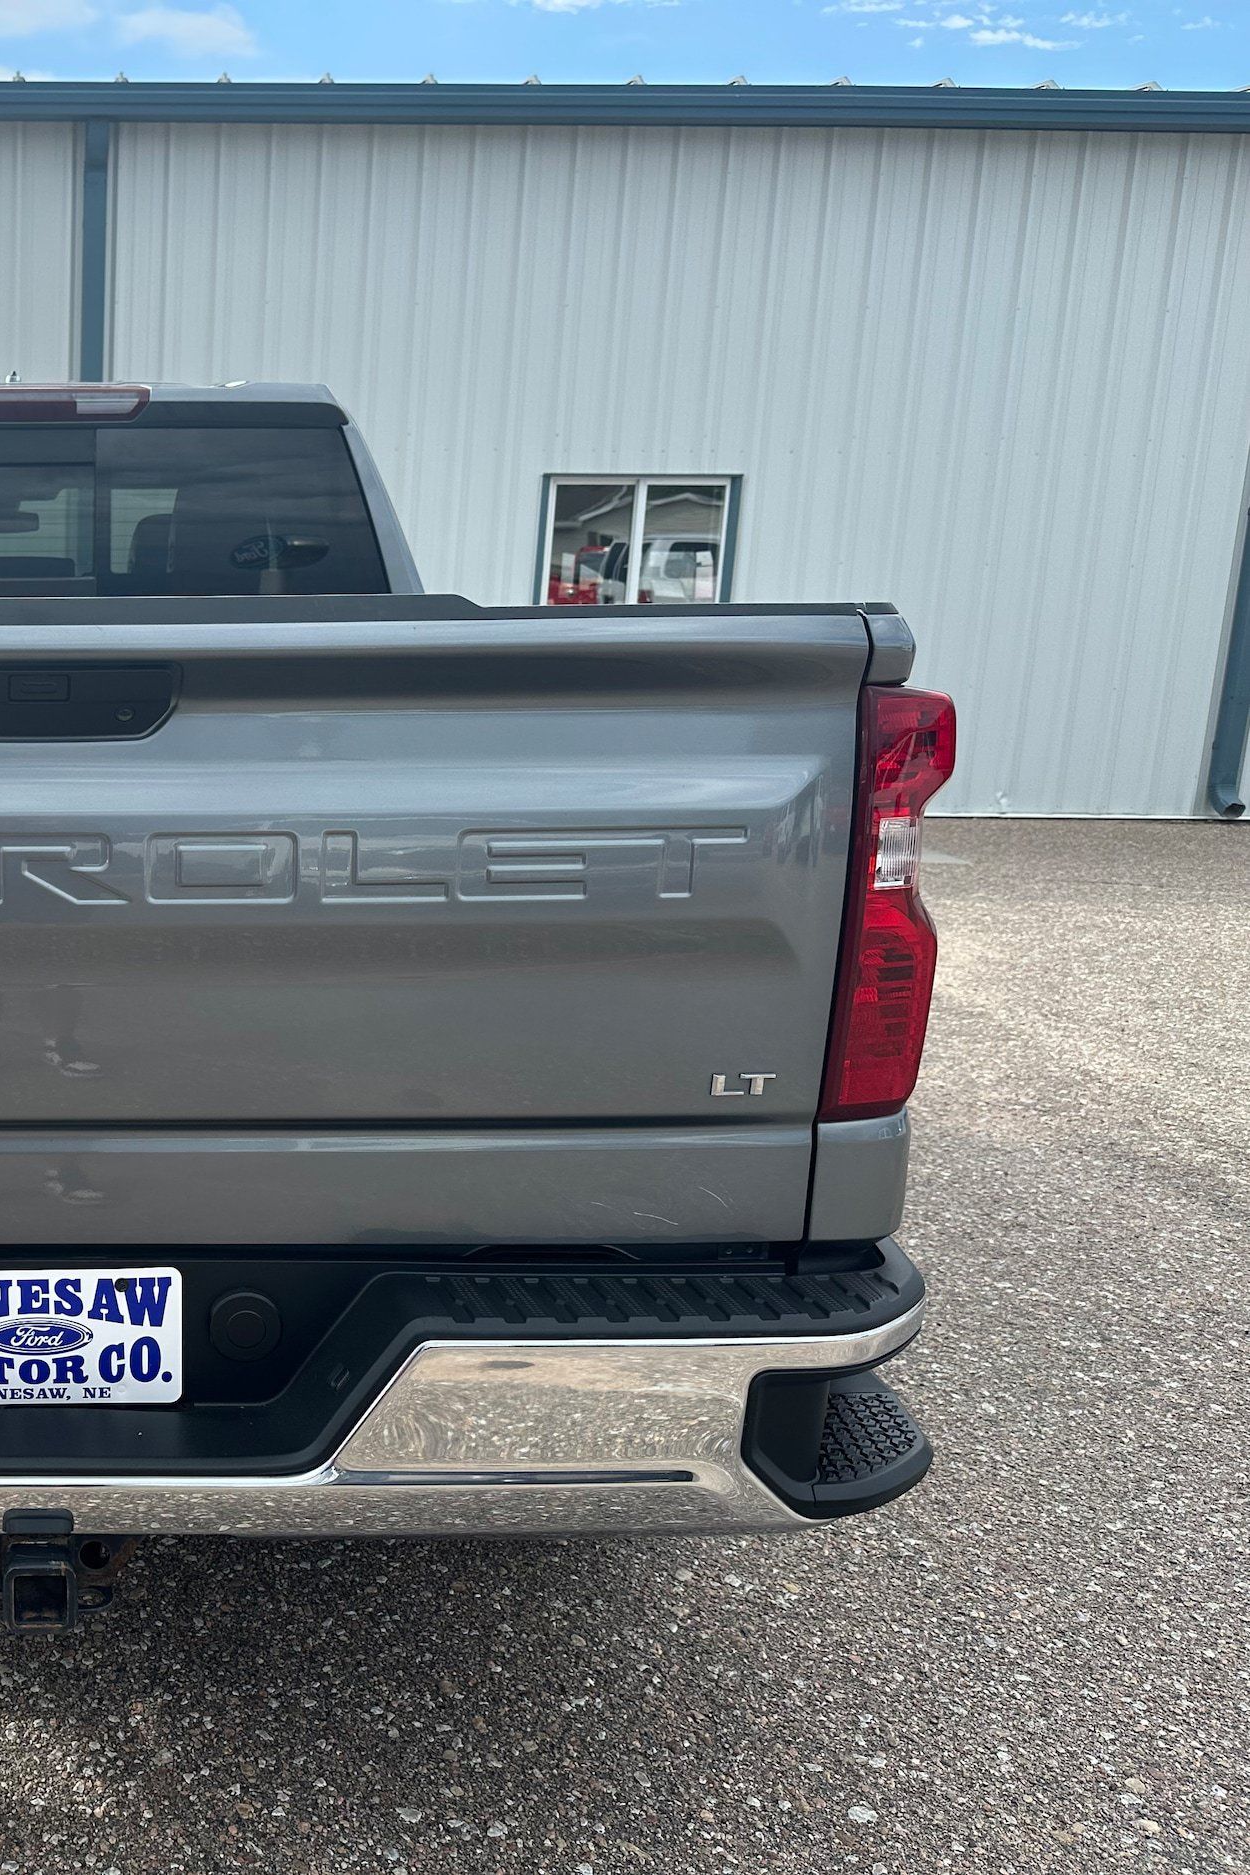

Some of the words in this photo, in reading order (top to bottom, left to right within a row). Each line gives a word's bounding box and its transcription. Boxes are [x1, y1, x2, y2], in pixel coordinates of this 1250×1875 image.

[710, 1072, 777, 1096] LT
[10, 1326, 64, 1347] Ford
[98, 1336, 173, 1384] CO.
[82, 1386, 111, 1399] NE
